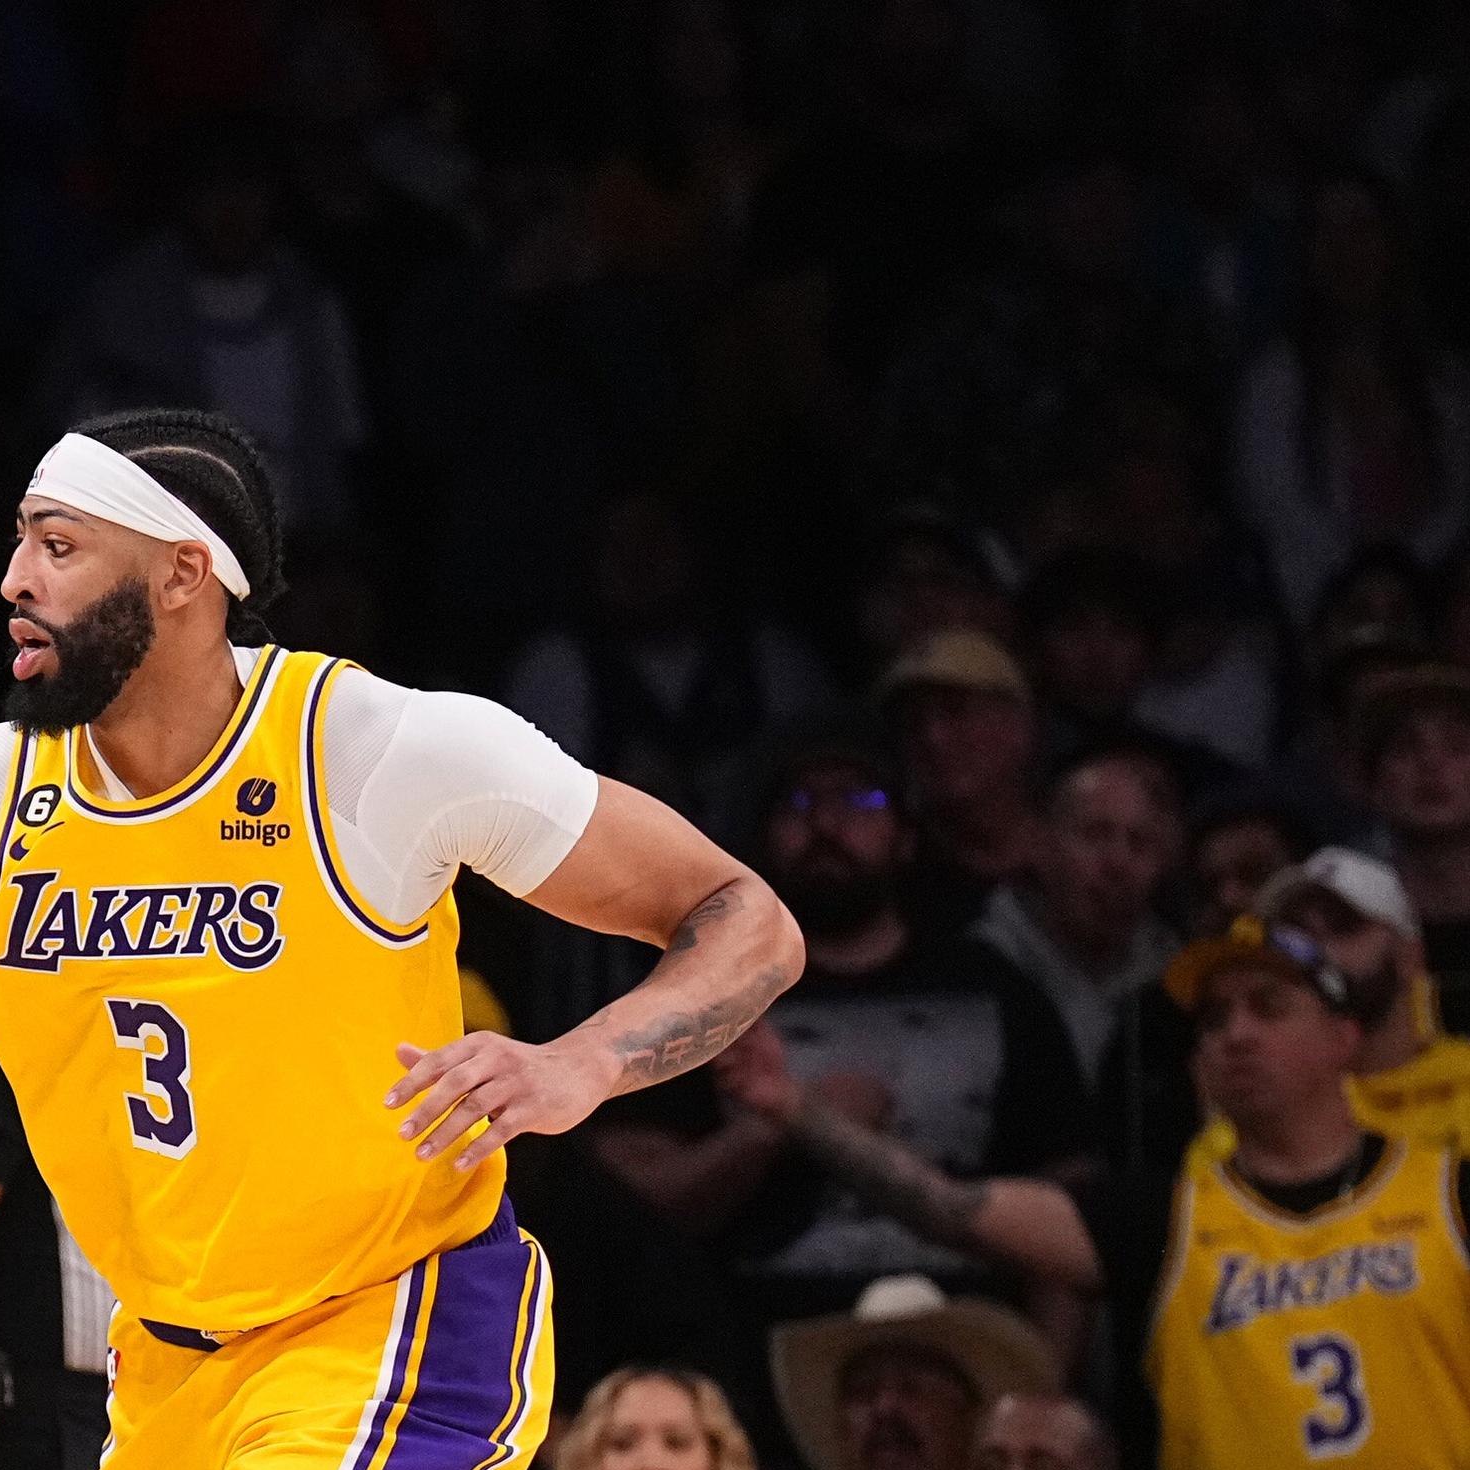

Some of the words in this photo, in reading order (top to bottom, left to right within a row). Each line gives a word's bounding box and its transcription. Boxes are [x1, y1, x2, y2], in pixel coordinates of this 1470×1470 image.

[27, 789, 54, 823] 6
[220, 820, 291, 847] bibigo
[102, 997, 198, 1161] 3
[1290, 1332, 1374, 1461] 3
